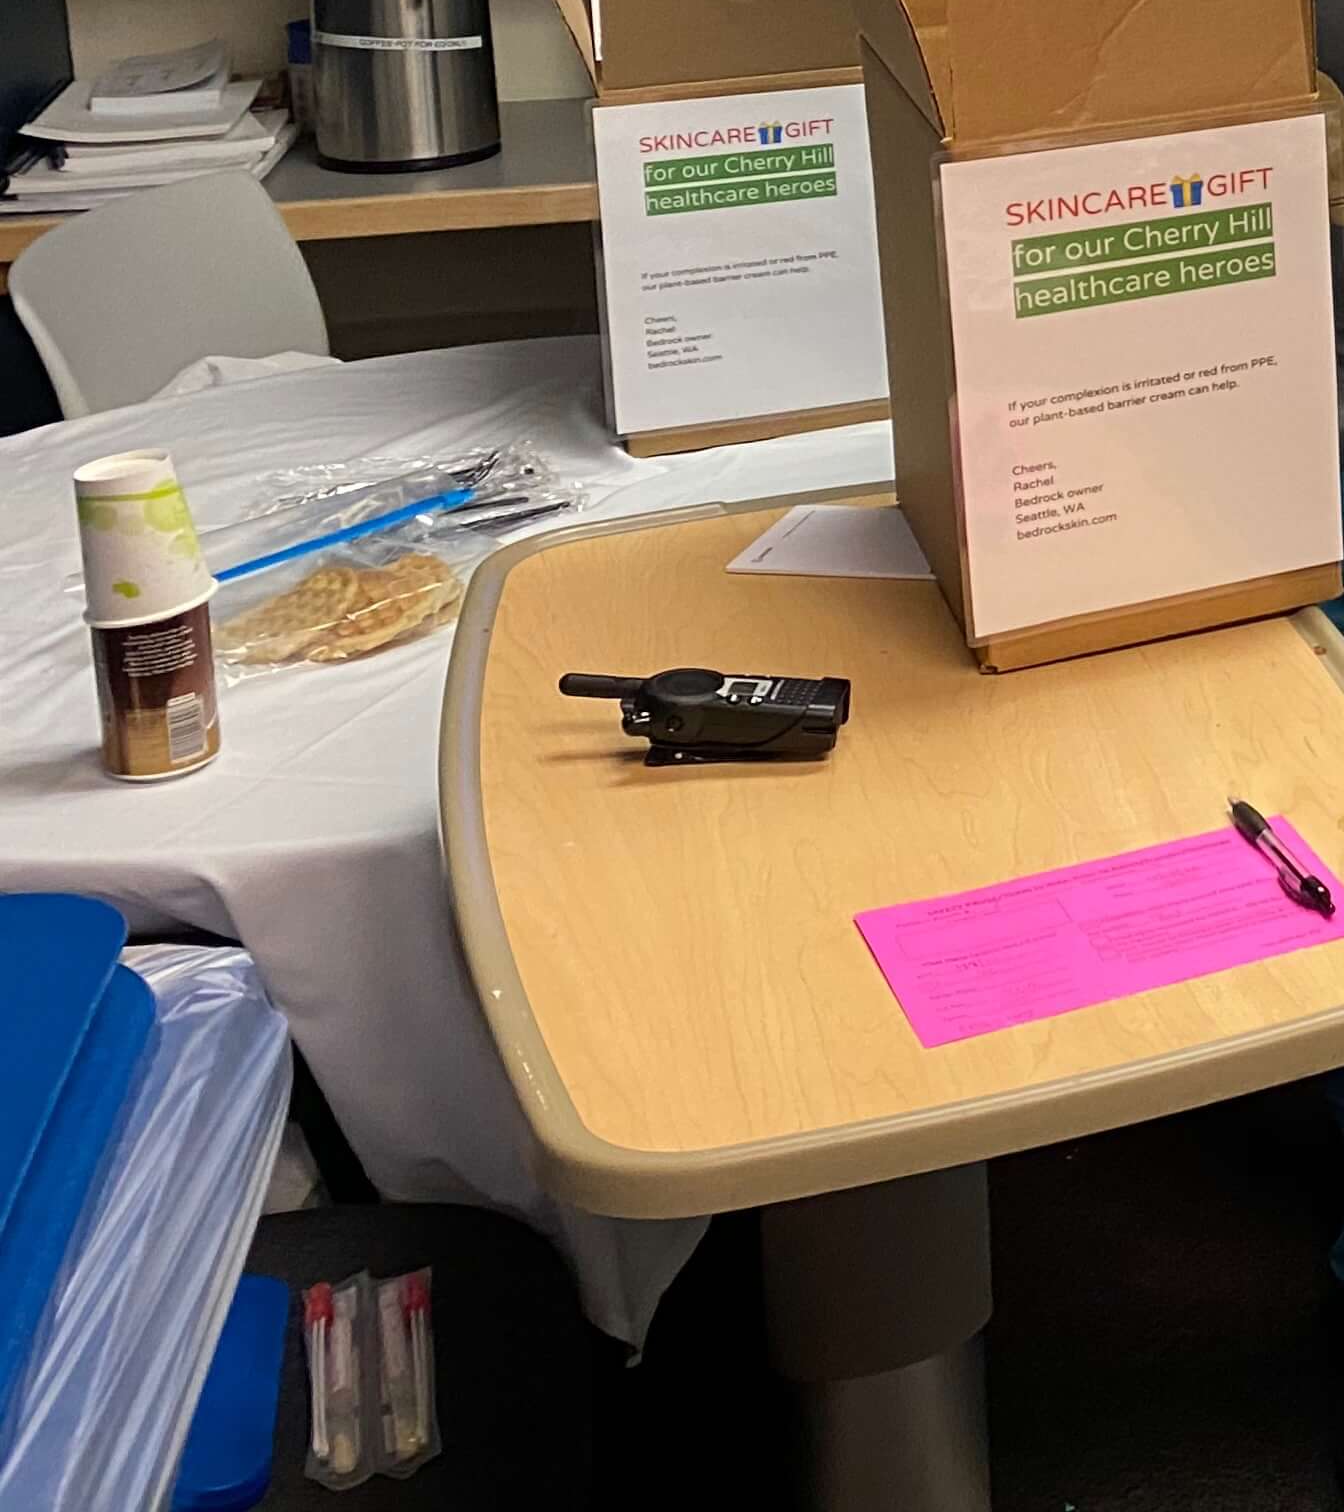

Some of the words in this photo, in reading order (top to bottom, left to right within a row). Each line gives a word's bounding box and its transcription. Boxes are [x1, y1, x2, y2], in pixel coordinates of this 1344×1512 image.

[639, 126, 757, 154] SKINCARE
[785, 118, 835, 140] GIFT
[645, 164, 676, 183] for
[682, 163, 719, 178] our
[724, 153, 795, 176] Cherry
[801, 145, 834, 166] Hill
[646, 184, 759, 212] healthcare
[765, 177, 837, 199] heroes
[1006, 182, 1167, 227] SKINCARE
[1207, 167, 1274, 197] GIFT
[1013, 243, 1056, 269] for
[1065, 236, 1115, 258] our
[1124, 221, 1219, 251] Cherry
[1229, 207, 1272, 235] Hill
[1015, 267, 1171, 311] healthcare
[1180, 251, 1275, 284] heroes
[1008, 401, 1017, 412] If
[1019, 397, 1047, 411] your
[1050, 383, 1120, 406] complexion
[1122, 381, 1132, 392] is
[1134, 372, 1181, 390] irritated
[1183, 370, 1196, 381] or
[1198, 365, 1218, 379] red
[1221, 361, 1248, 375] from
[1009, 416, 1030, 428] our
[1033, 402, 1105, 426] plant-based
[1107, 395, 1147, 411] barrier
[1149, 389, 1186, 404] cream
[1188, 383, 1210, 396] can
[1012, 460, 1057, 477] Cheers,
[1013, 475, 1055, 492] Rachel
[1015, 491, 1064, 509] Bedrock
[1066, 483, 1104, 499] owner
[1015, 507, 1061, 525] Seattle,
[1063, 501, 1086, 515] WA
[1016, 511, 1118, 541] bedrockskin.com
